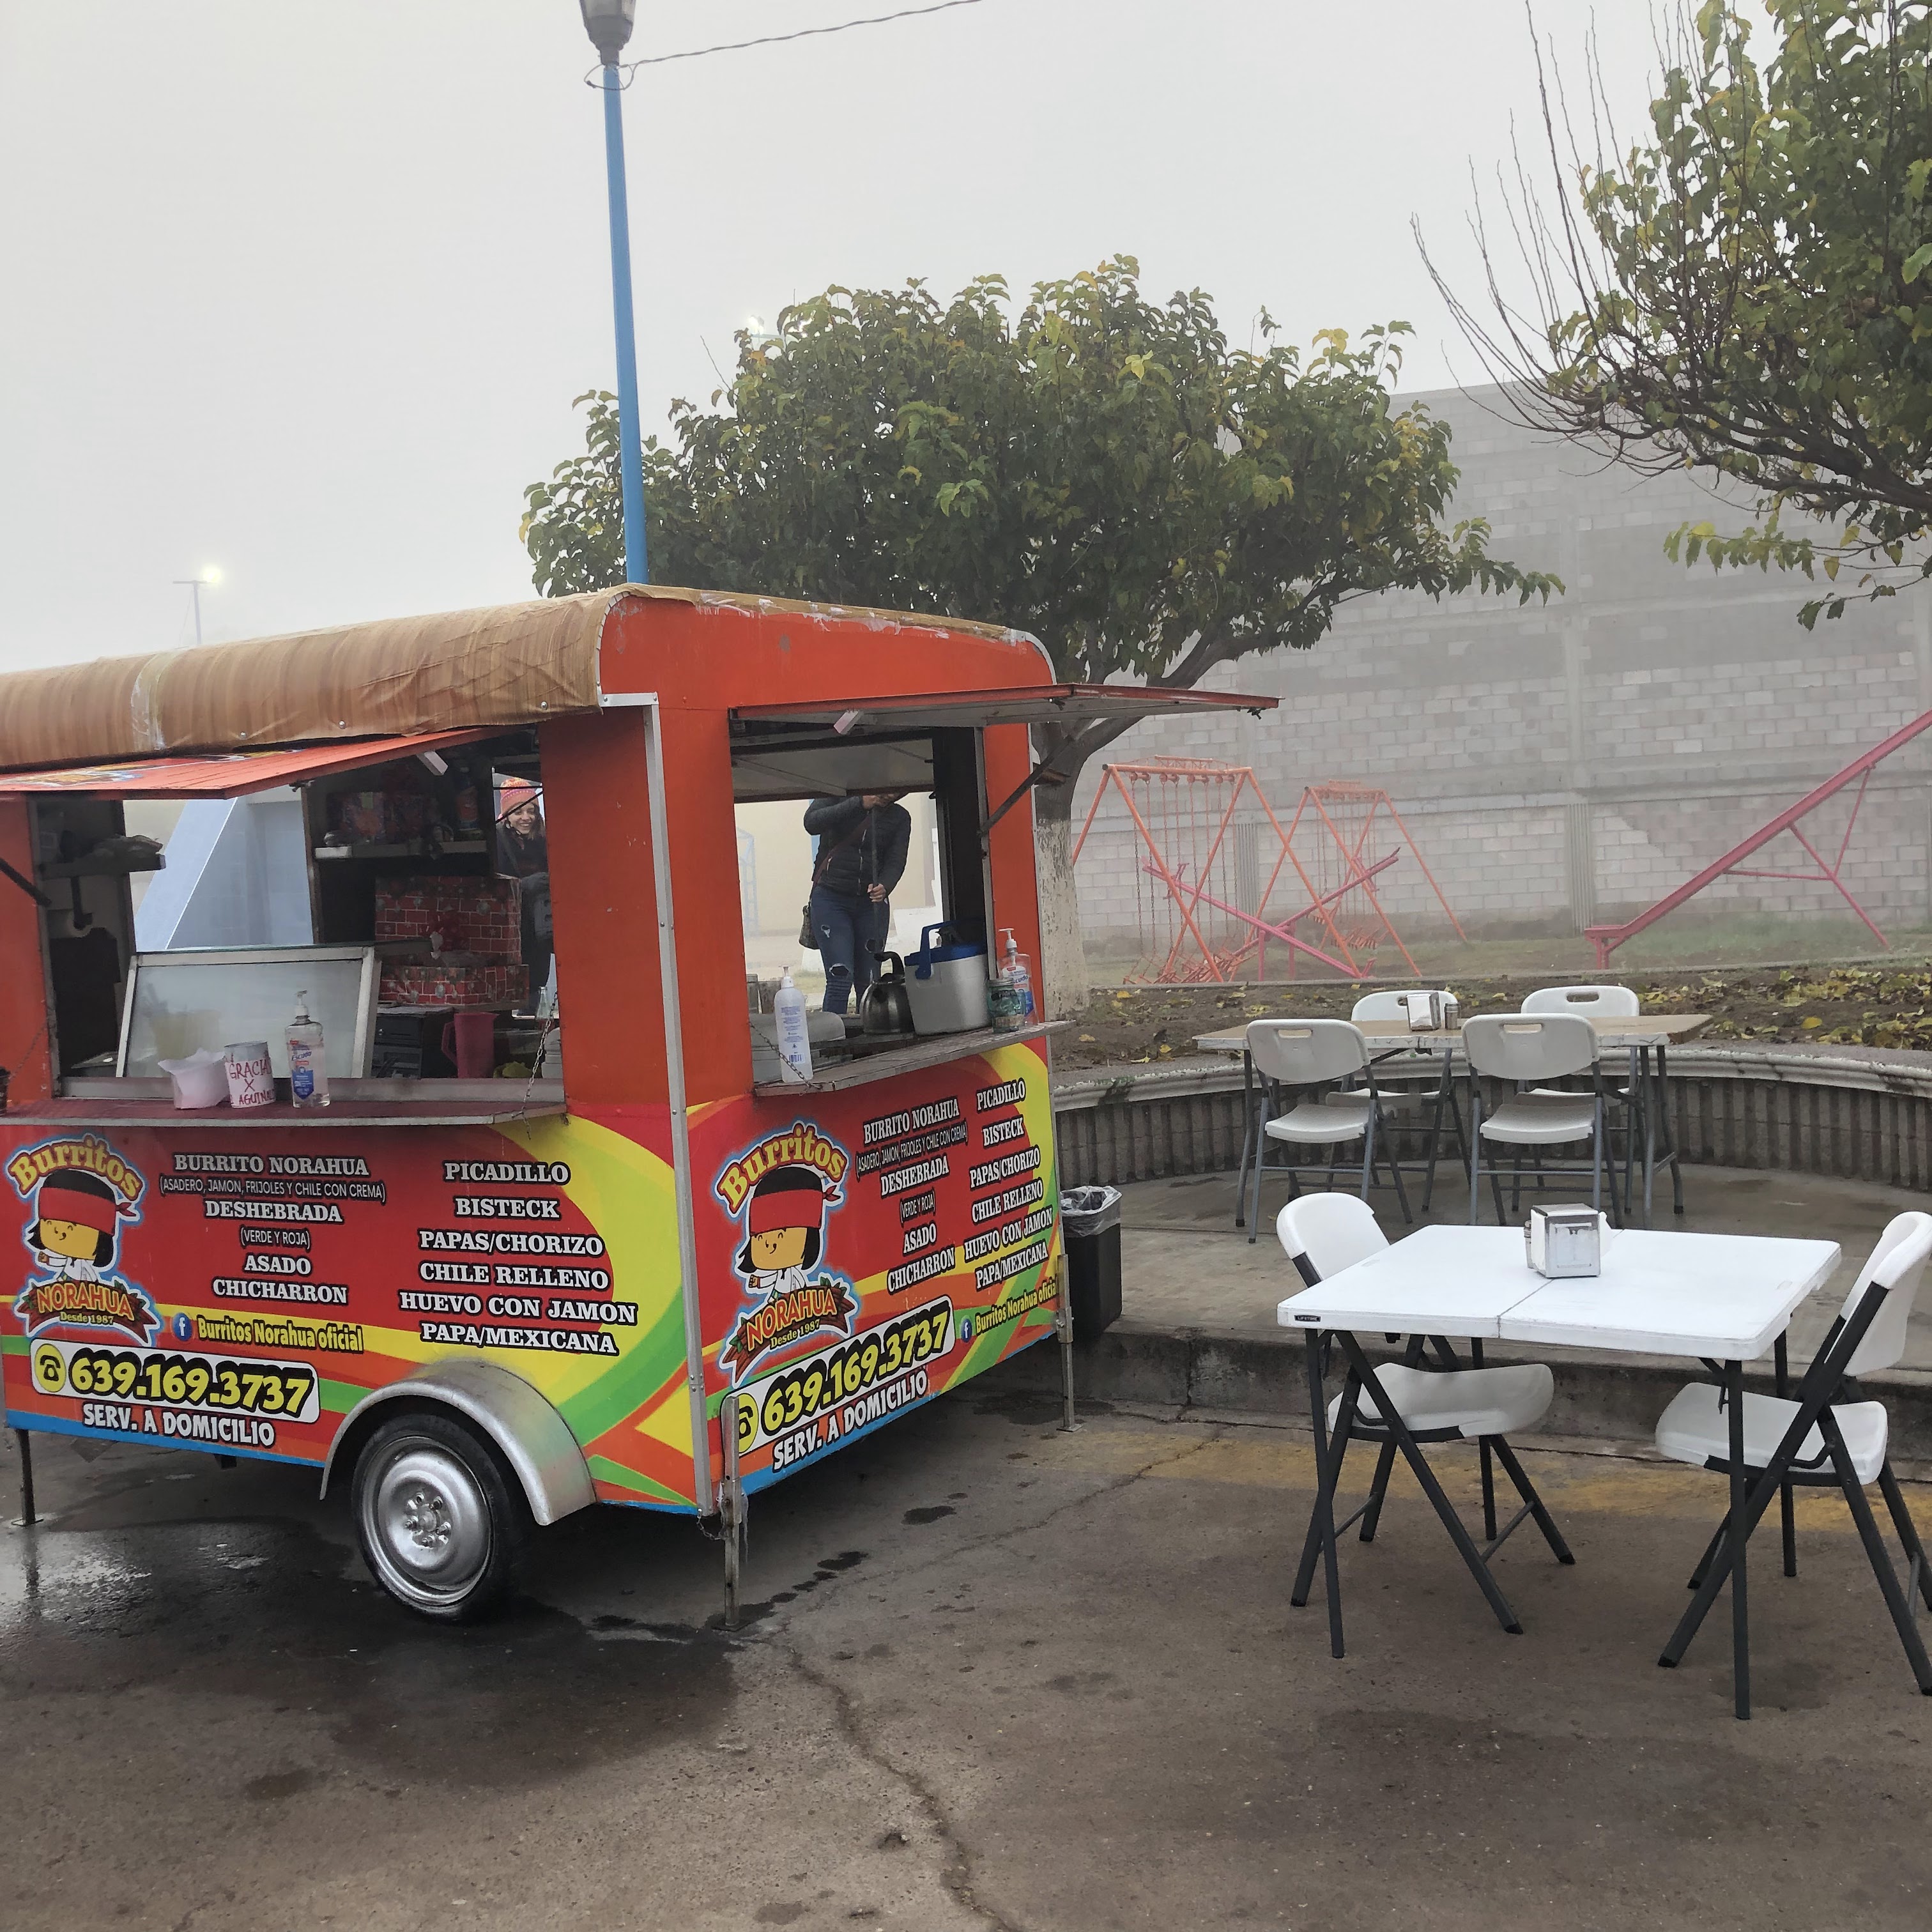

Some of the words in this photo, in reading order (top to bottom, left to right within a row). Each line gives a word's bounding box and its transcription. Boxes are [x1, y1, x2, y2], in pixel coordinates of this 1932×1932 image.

[977, 1081, 1025, 1111] PICADILLO
[864, 1112, 910, 1144] BURRITO
[912, 1098, 960, 1130] NORAHUA
[983, 1118, 1024, 1147] BISTECK
[900, 1138, 921, 1158] FRIJOLES
[921, 1137, 926, 1151] Y
[926, 1133, 939, 1150] CHILE
[939, 1130, 951, 1146] CON
[12, 1138, 142, 1197] Burritos
[174, 1154, 264, 1173] BURRITO
[269, 1157, 369, 1176] NORAHUA
[445, 1163, 569, 1183] PICADILLO
[720, 1128, 846, 1208] Burritos
[881, 1154, 949, 1196] DESHEBRADA
[970, 1148, 1040, 1188] PAPAS/CHORIZO
[160, 1176, 206, 1194] (ASADERO,
[208, 1179, 244, 1195] JAMON,
[245, 1181, 284, 1195] FRIJOLES
[287, 1182, 293, 1195] Y
[295, 1182, 322, 1196] CHILE
[324, 1183, 347, 1197] CON
[349, 1183, 386, 1202] CREMA)
[972, 1199, 1001, 1223] CHILE
[1003, 1179, 1043, 1209] RELLENO
[205, 1200, 343, 1222] DESHEBRADA
[456, 1198, 560, 1218] BISTECK
[900, 1197, 917, 1223] (VERDE
[917, 1199, 921, 1214] Y
[921, 1192, 935, 1211] ROJA)
[241, 1227, 272, 1246] (VERDE
[274, 1231, 280, 1244] Y
[282, 1231, 311, 1249] ROJA)
[419, 1230, 603, 1255] PAPAS/CHORIZO
[903, 1223, 937, 1254] ASADO
[964, 1232, 1000, 1260] HUEVO
[1002, 1221, 1022, 1246] CON
[1024, 1208, 1053, 1236] JAMON
[244, 1255, 312, 1275] ASADO
[420, 1262, 489, 1282] CHILE
[495, 1266, 608, 1289] RELLENO
[887, 1247, 955, 1292] CHICHARRON
[976, 1241, 1048, 1289] PAPA/MEXICANA
[36, 1282, 134, 1321] NORAHUA
[213, 1278, 348, 1303] CHICHARRON
[976, 1307, 1006, 1333] Burritos
[1008, 1291, 1038, 1318] Norahua
[1038, 1279, 1057, 1302] oficia
[59, 1312, 88, 1322] Desde
[91, 1314, 114, 1325] 1987
[399, 1292, 481, 1314] HUEVO
[488, 1297, 540, 1317] CON
[548, 1300, 636, 1323] JAMON
[746, 1289, 837, 1351] NORAHUA
[197, 1317, 251, 1342] Burritos
[256, 1322, 316, 1347] Norahua
[318, 1325, 364, 1351] oficial
[422, 1322, 617, 1354] PAPA/MEXICANA
[770, 1331, 797, 1348] Desde
[799, 1319, 820, 1336] 1987
[72, 1356, 310, 1414] 639.169.3737
[764, 1310, 949, 1431] 639.169.3737
[84, 1404, 138, 1431] SERV.
[144, 1411, 157, 1434] A
[163, 1413, 275, 1446] DOMICILIO
[774, 1424, 822, 1469] SERV.
[828, 1414, 839, 1443] A
[843, 1370, 927, 1433] DOMICILIO
